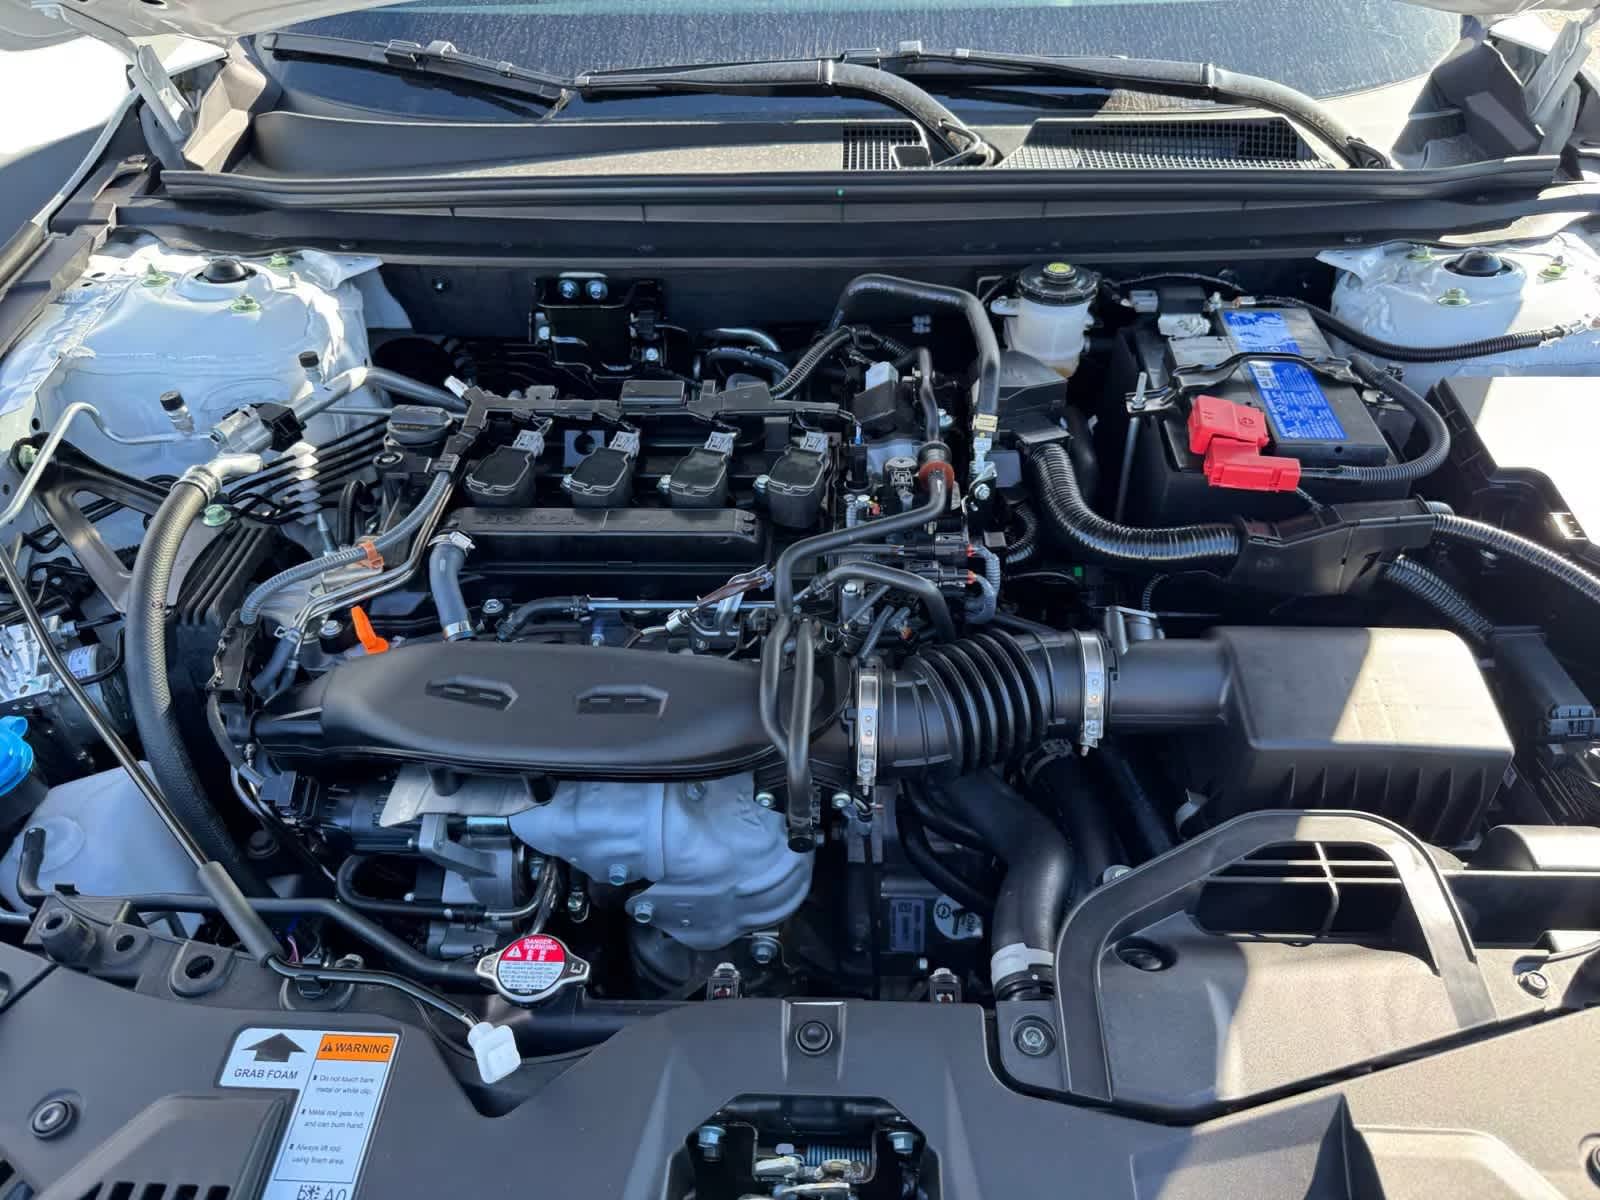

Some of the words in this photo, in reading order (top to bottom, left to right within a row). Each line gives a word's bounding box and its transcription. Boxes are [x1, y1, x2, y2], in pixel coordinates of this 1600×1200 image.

[335, 1042, 390, 1054] WARNING
[233, 1068, 265, 1079] GRAB
[266, 1069, 299, 1080] FOAM
[341, 1075, 358, 1083] touch
[342, 1087, 359, 1095] white
[308, 1108, 325, 1116] Metal
[304, 1120, 316, 1128] and
[296, 1143, 319, 1152] Always
